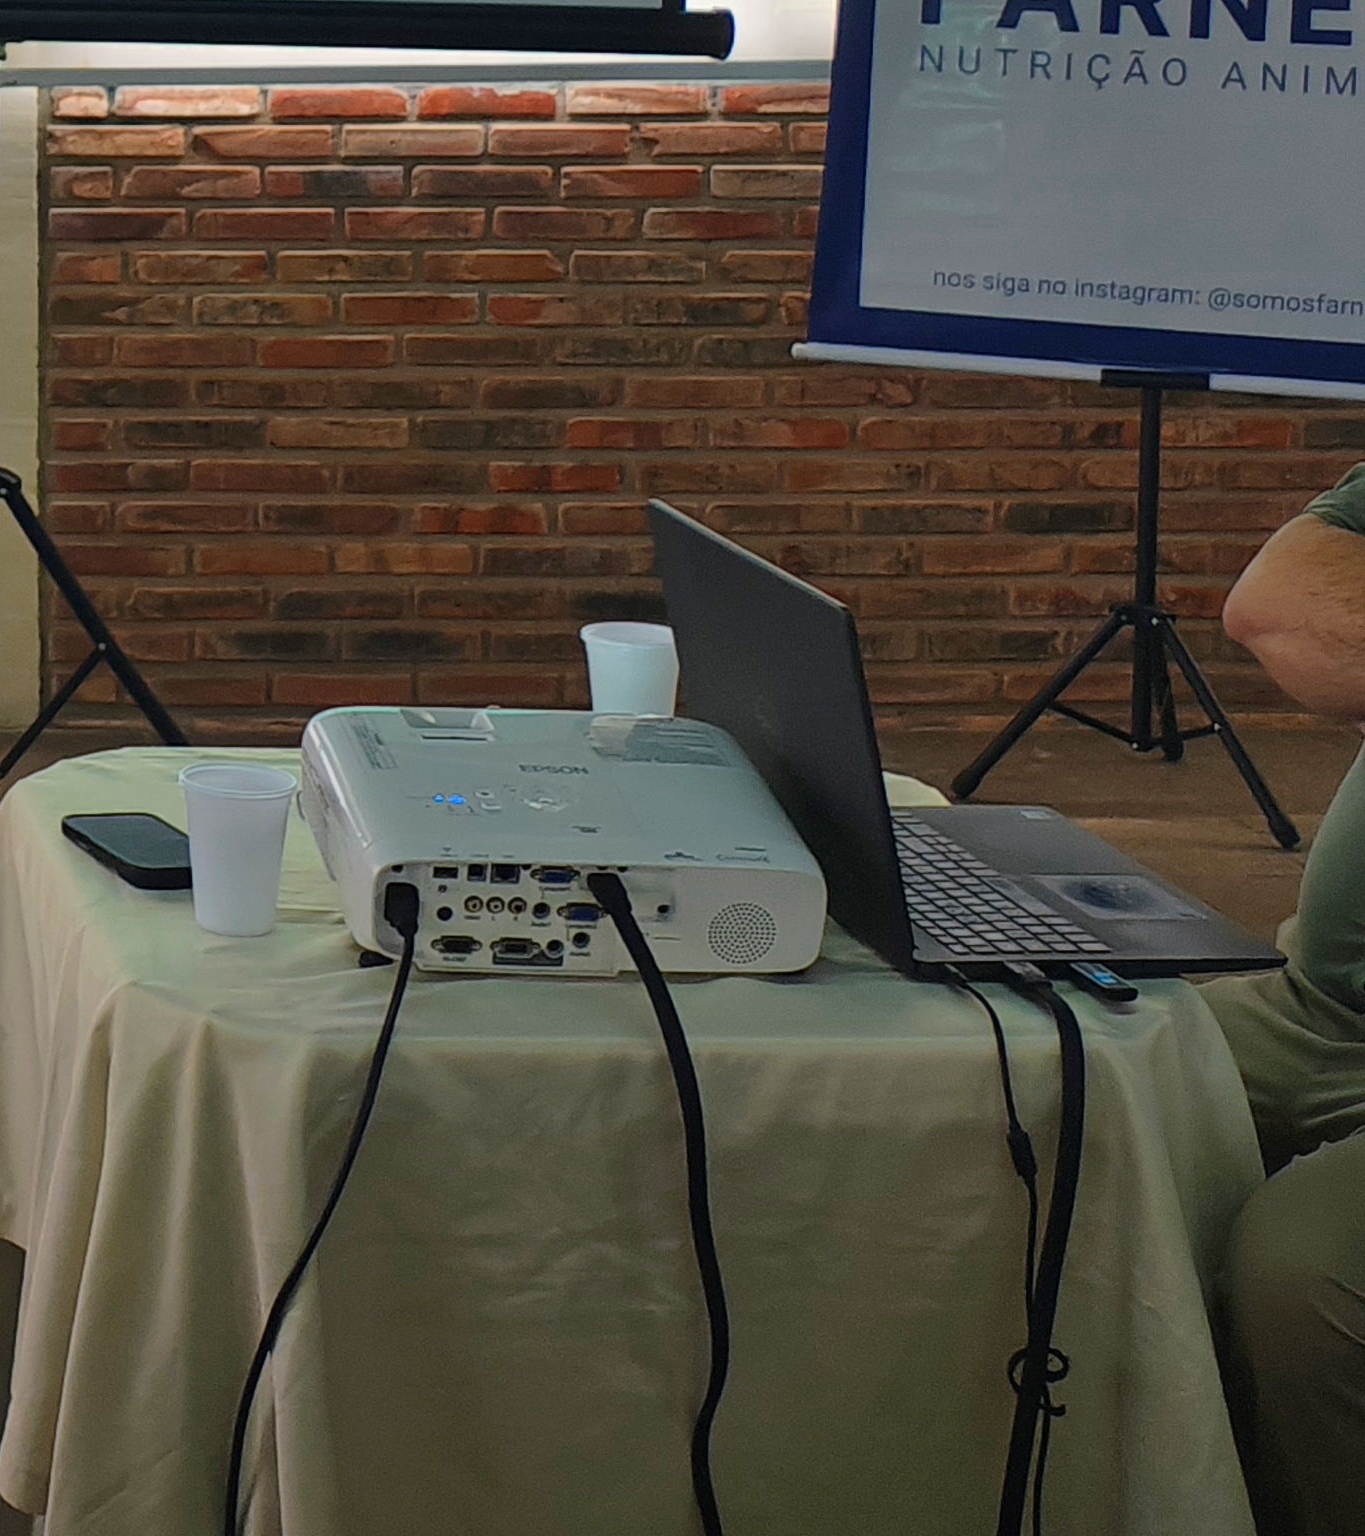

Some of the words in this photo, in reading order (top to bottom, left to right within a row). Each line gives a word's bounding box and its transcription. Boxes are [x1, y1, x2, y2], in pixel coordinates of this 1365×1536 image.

[920, 45, 1186, 89] NUTRIÇÃO
[1222, 64, 1358, 96] ANIM
[934, 272, 975, 288] nos
[983, 272, 1030, 296] siga
[1038, 280, 1066, 295] no
[1074, 278, 1200, 306] instagram:
